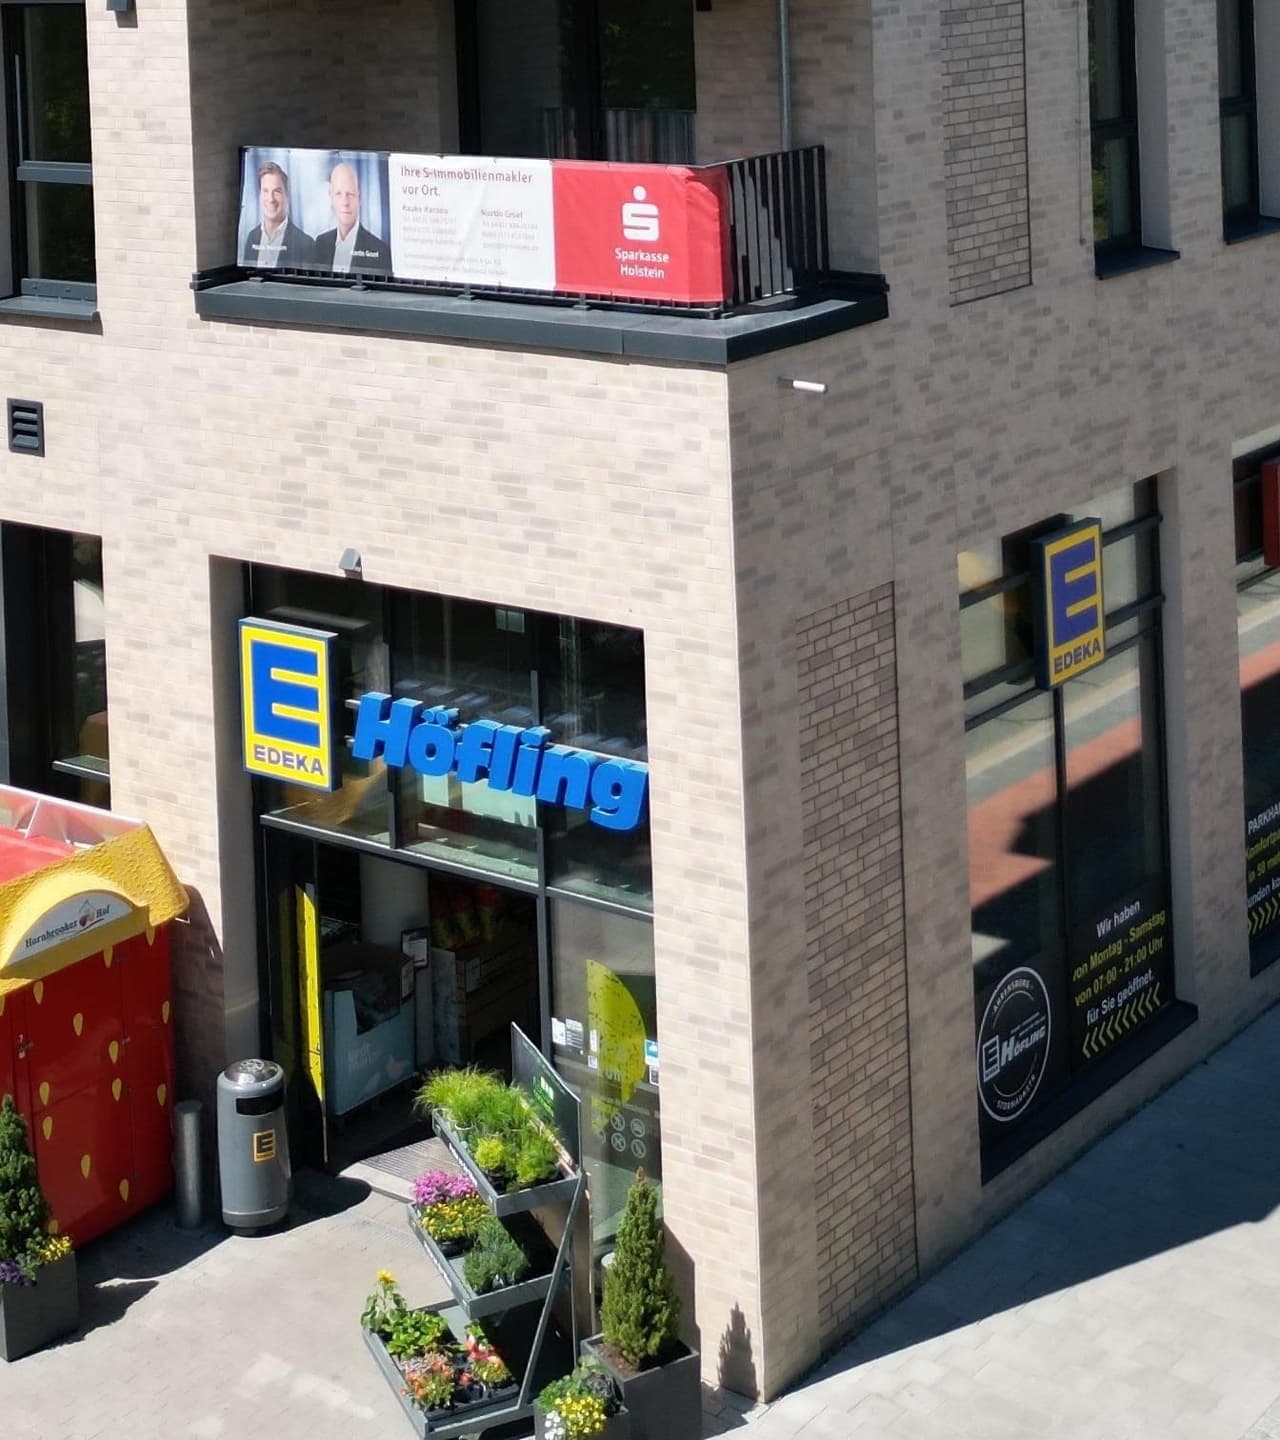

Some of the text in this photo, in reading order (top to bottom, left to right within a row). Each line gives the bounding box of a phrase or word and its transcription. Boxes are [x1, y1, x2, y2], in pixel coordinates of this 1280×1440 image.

[401, 165, 421, 178] Ihre
[402, 185, 418, 196] vor
[614, 248, 670, 263] Sparkasse
[620, 264, 665, 279] Holstein
[1050, 536, 1098, 648] E
[1054, 637, 1102, 675] EDEKA
[250, 639, 649, 832] E Höfling
[253, 743, 324, 777] EDEKA
[25, 919, 78, 949] Hornbrooker
[1096, 900, 1141, 939] Wir haben
[1090, 939, 1122, 971] Montag
[1129, 909, 1166, 943] Samstag
[1074, 986, 1092, 1007] von
[1093, 965, 1117, 994] 07:00
[1124, 945, 1147, 973] 21:00
[1148, 936, 1164, 955] Uhr
[1086, 1006, 1099, 1026] für
[1101, 995, 1116, 1016] Sie
[1000, 1025, 1046, 1067] HÖFLING
